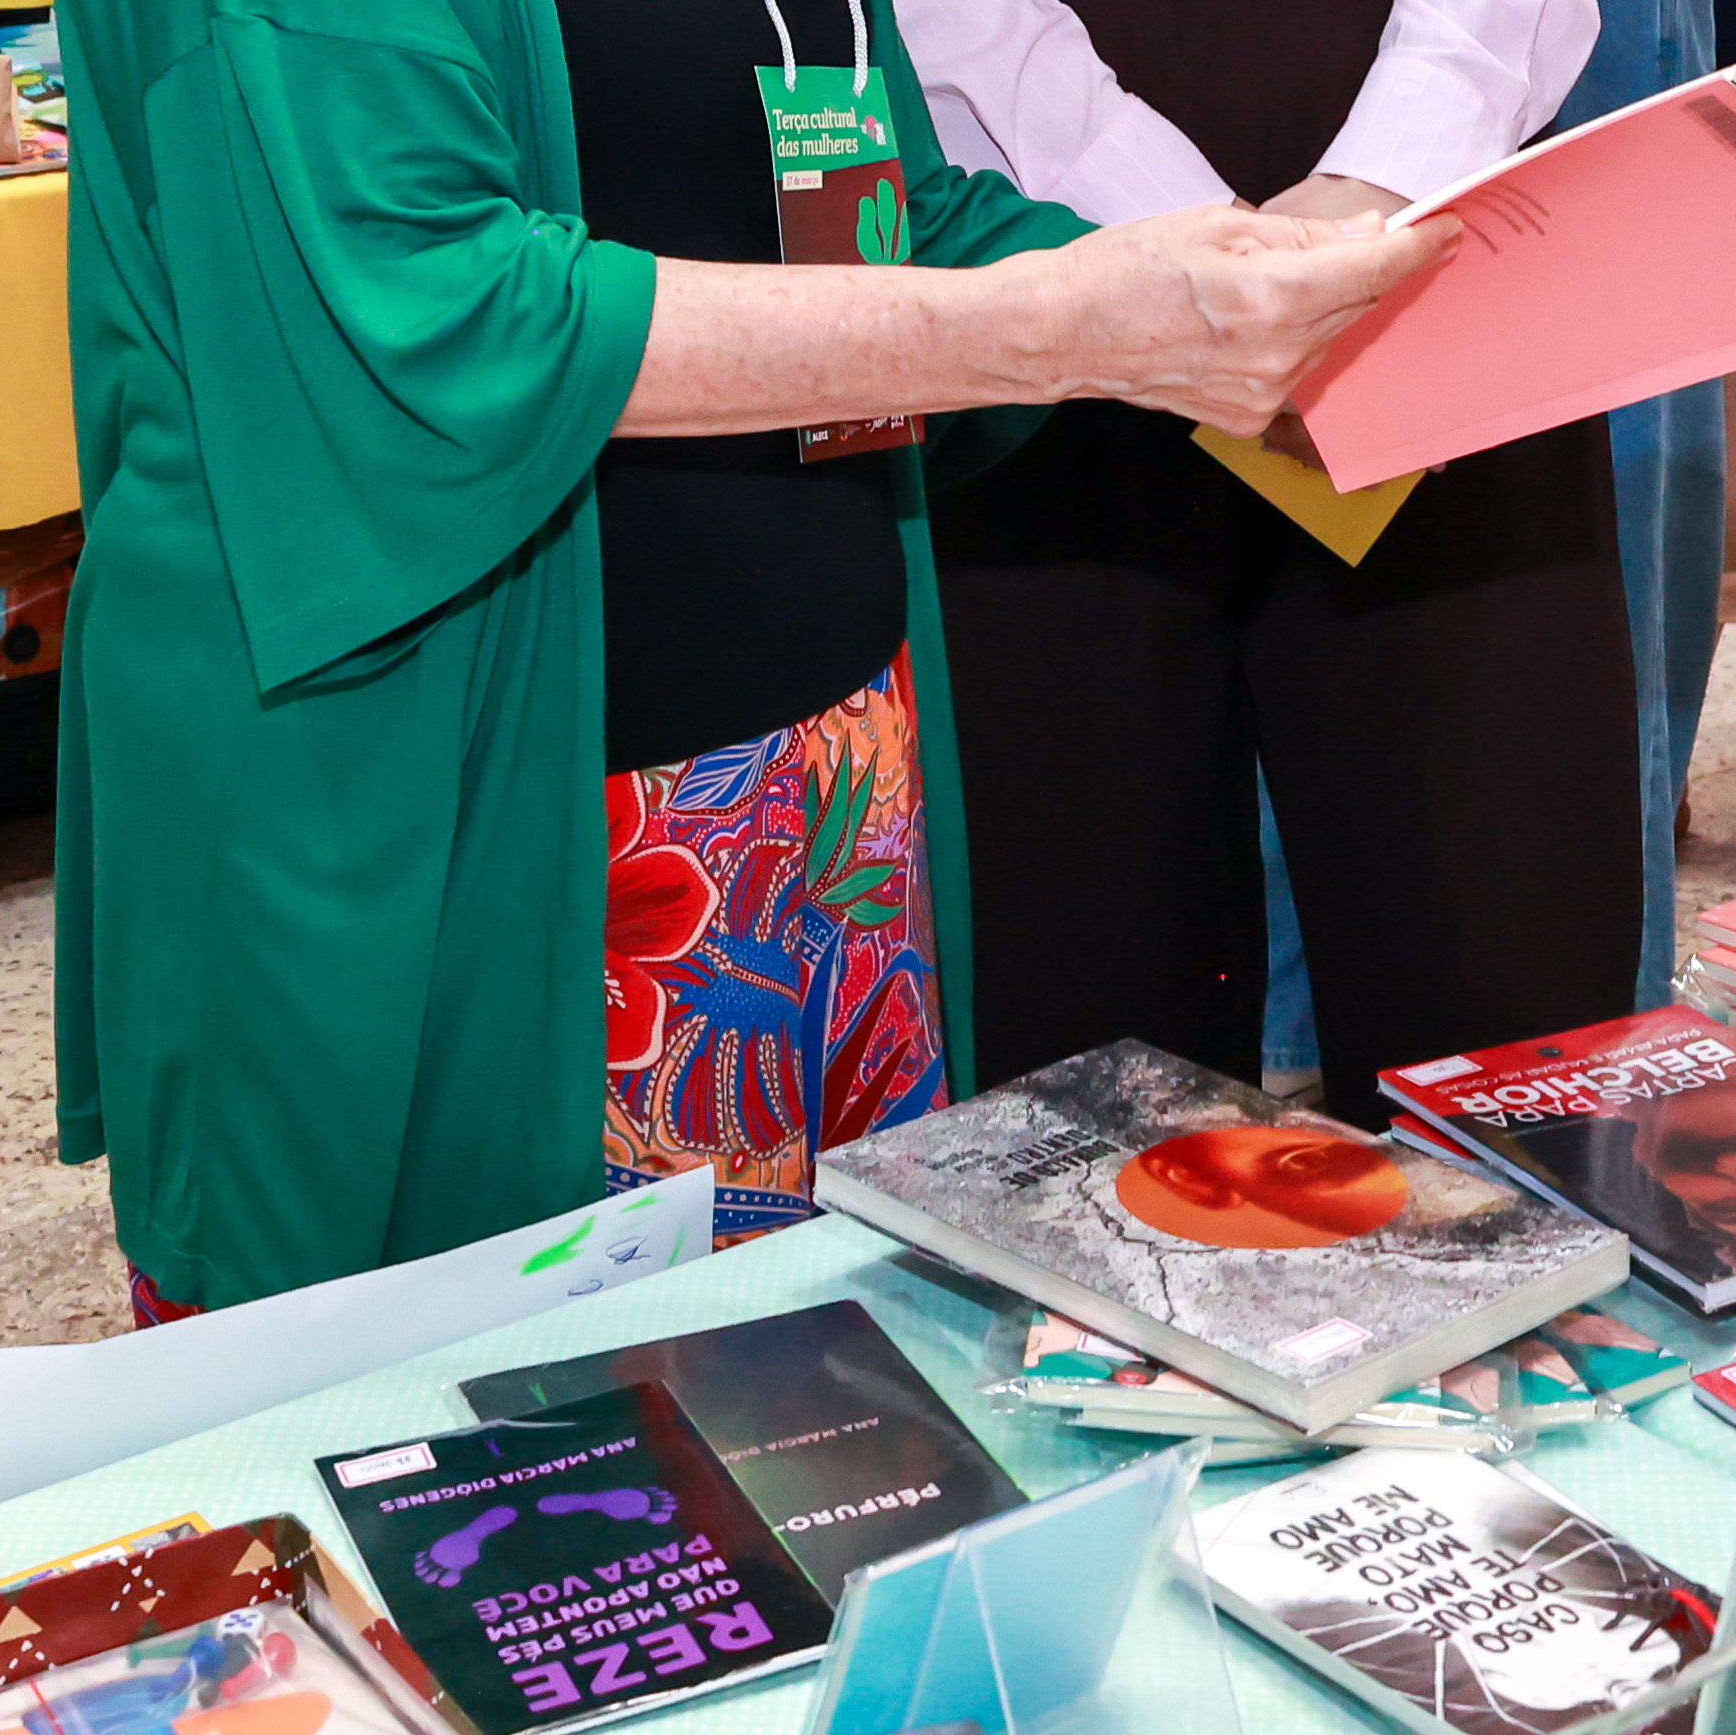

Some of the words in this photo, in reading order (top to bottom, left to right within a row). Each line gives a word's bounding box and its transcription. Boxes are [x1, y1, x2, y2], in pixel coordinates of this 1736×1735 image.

[773, 109, 809, 134] Terça
[810, 107, 857, 129] cultural
[777, 135, 799, 157] das
[802, 133, 859, 156] mulheres
[1451, 1038, 1736, 1113] BELCHIOR
[1474, 1096, 1598, 1128] PARA
[1006, 1129, 1093, 1164] DENTRO
[998, 1172, 1040, 1192] DE
[590, 1437, 637, 1459] ANA
[499, 1450, 589, 1485] MÁRCIA
[379, 1478, 498, 1513] DIÓGENES
[772, 1482, 942, 1532] PÉRFURO-
[1353, 1484, 1420, 1515] ME
[1270, 1508, 1356, 1549] AMO
[1304, 1508, 1454, 1573] PORQUE
[593, 1533, 713, 1585] PARA
[656, 1557, 728, 1589] NÃO
[1359, 1534, 1471, 1586] MATO
[1470, 1550, 1527, 1578] TE
[472, 1575, 591, 1623] VOCÊ
[670, 1578, 740, 1612] QUE
[1368, 1569, 1472, 1613] AMO,
[1413, 1572, 1565, 1640] PORQUE
[484, 1581, 650, 1643] APONTEM
[569, 1601, 668, 1645] MEUS
[1472, 1604, 1580, 1653] CASO
[498, 1637, 566, 1665] PÉS
[511, 1601, 774, 1713] REZE
